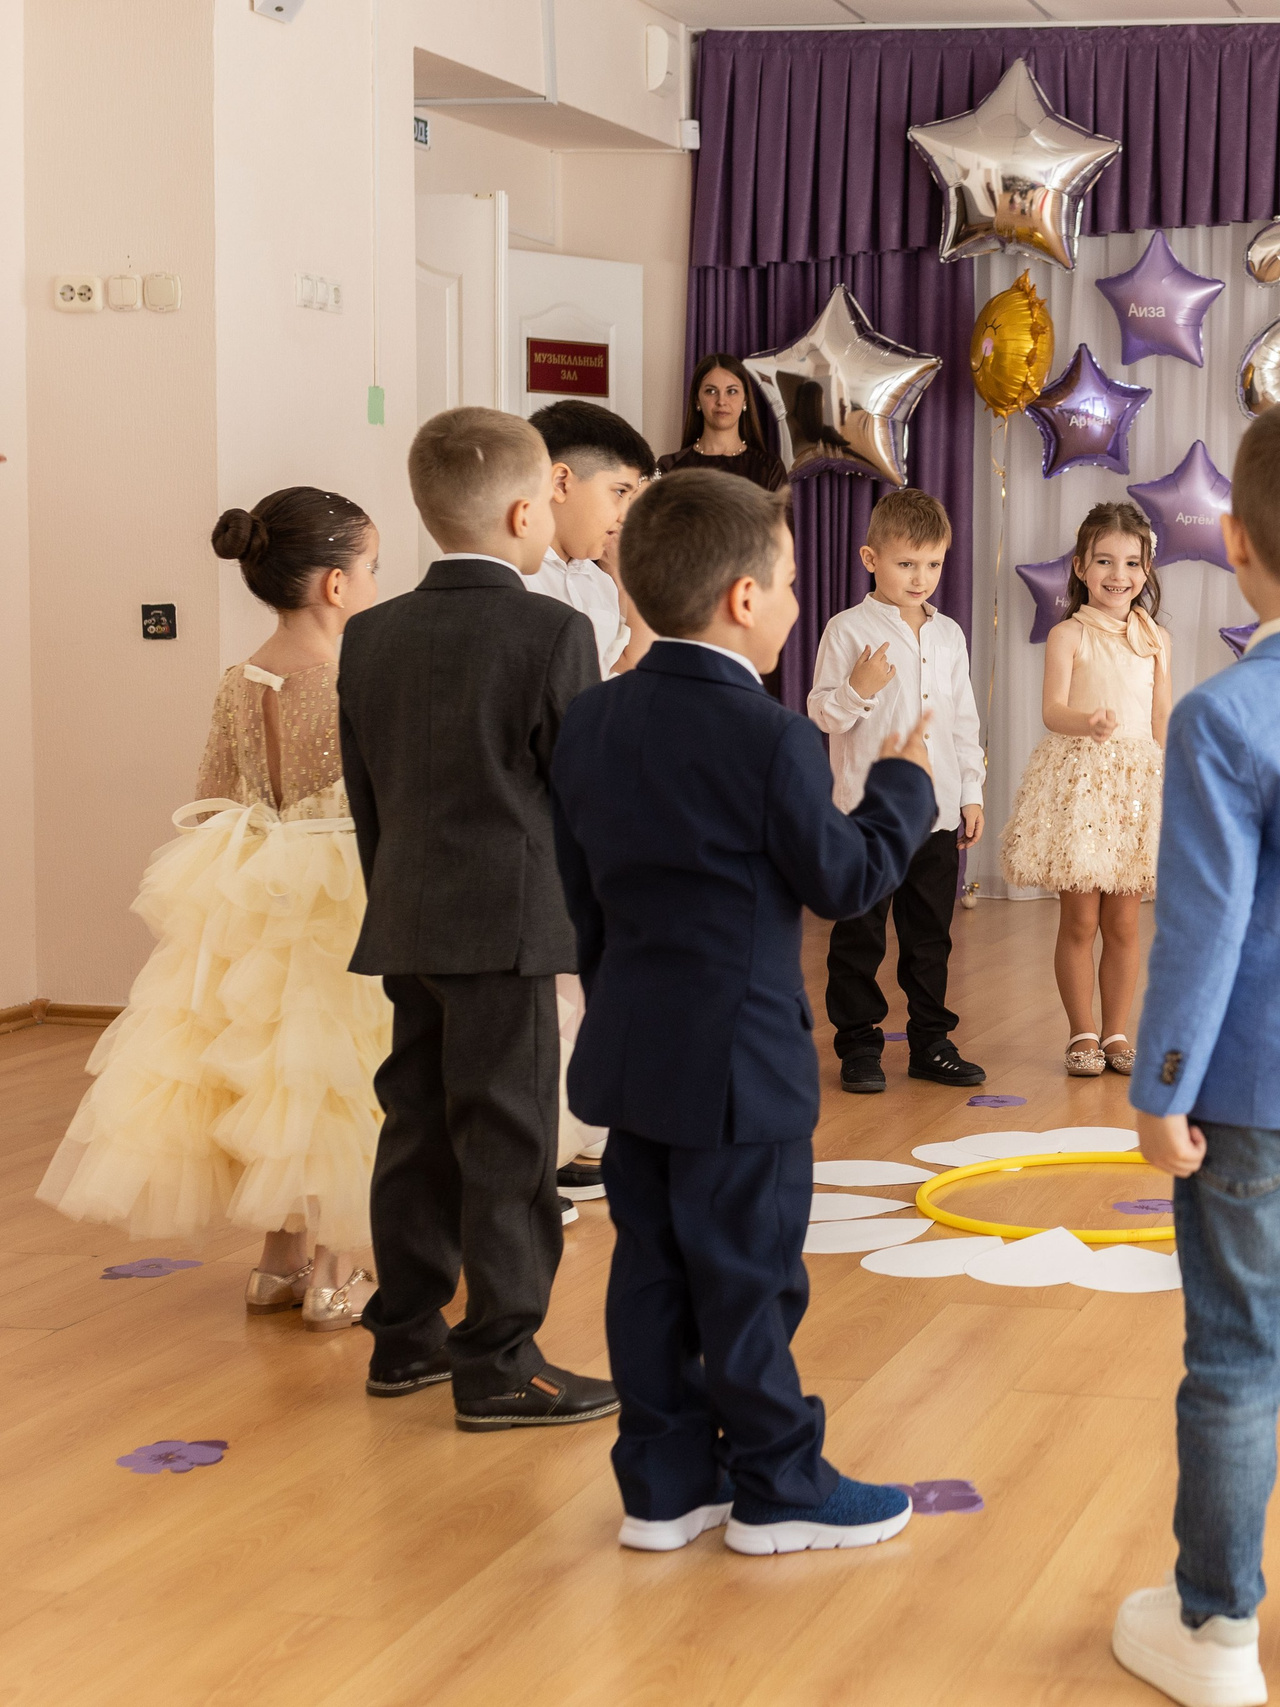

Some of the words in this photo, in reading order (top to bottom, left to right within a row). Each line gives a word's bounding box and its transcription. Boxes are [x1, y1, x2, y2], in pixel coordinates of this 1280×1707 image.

[1127, 302, 1166, 318] Аиза
[533, 352, 604, 368] МУЗЫКАЛЬНЫЙ
[560, 369, 578, 381] ЗАЛ
[1175, 511, 1215, 526] Артём
